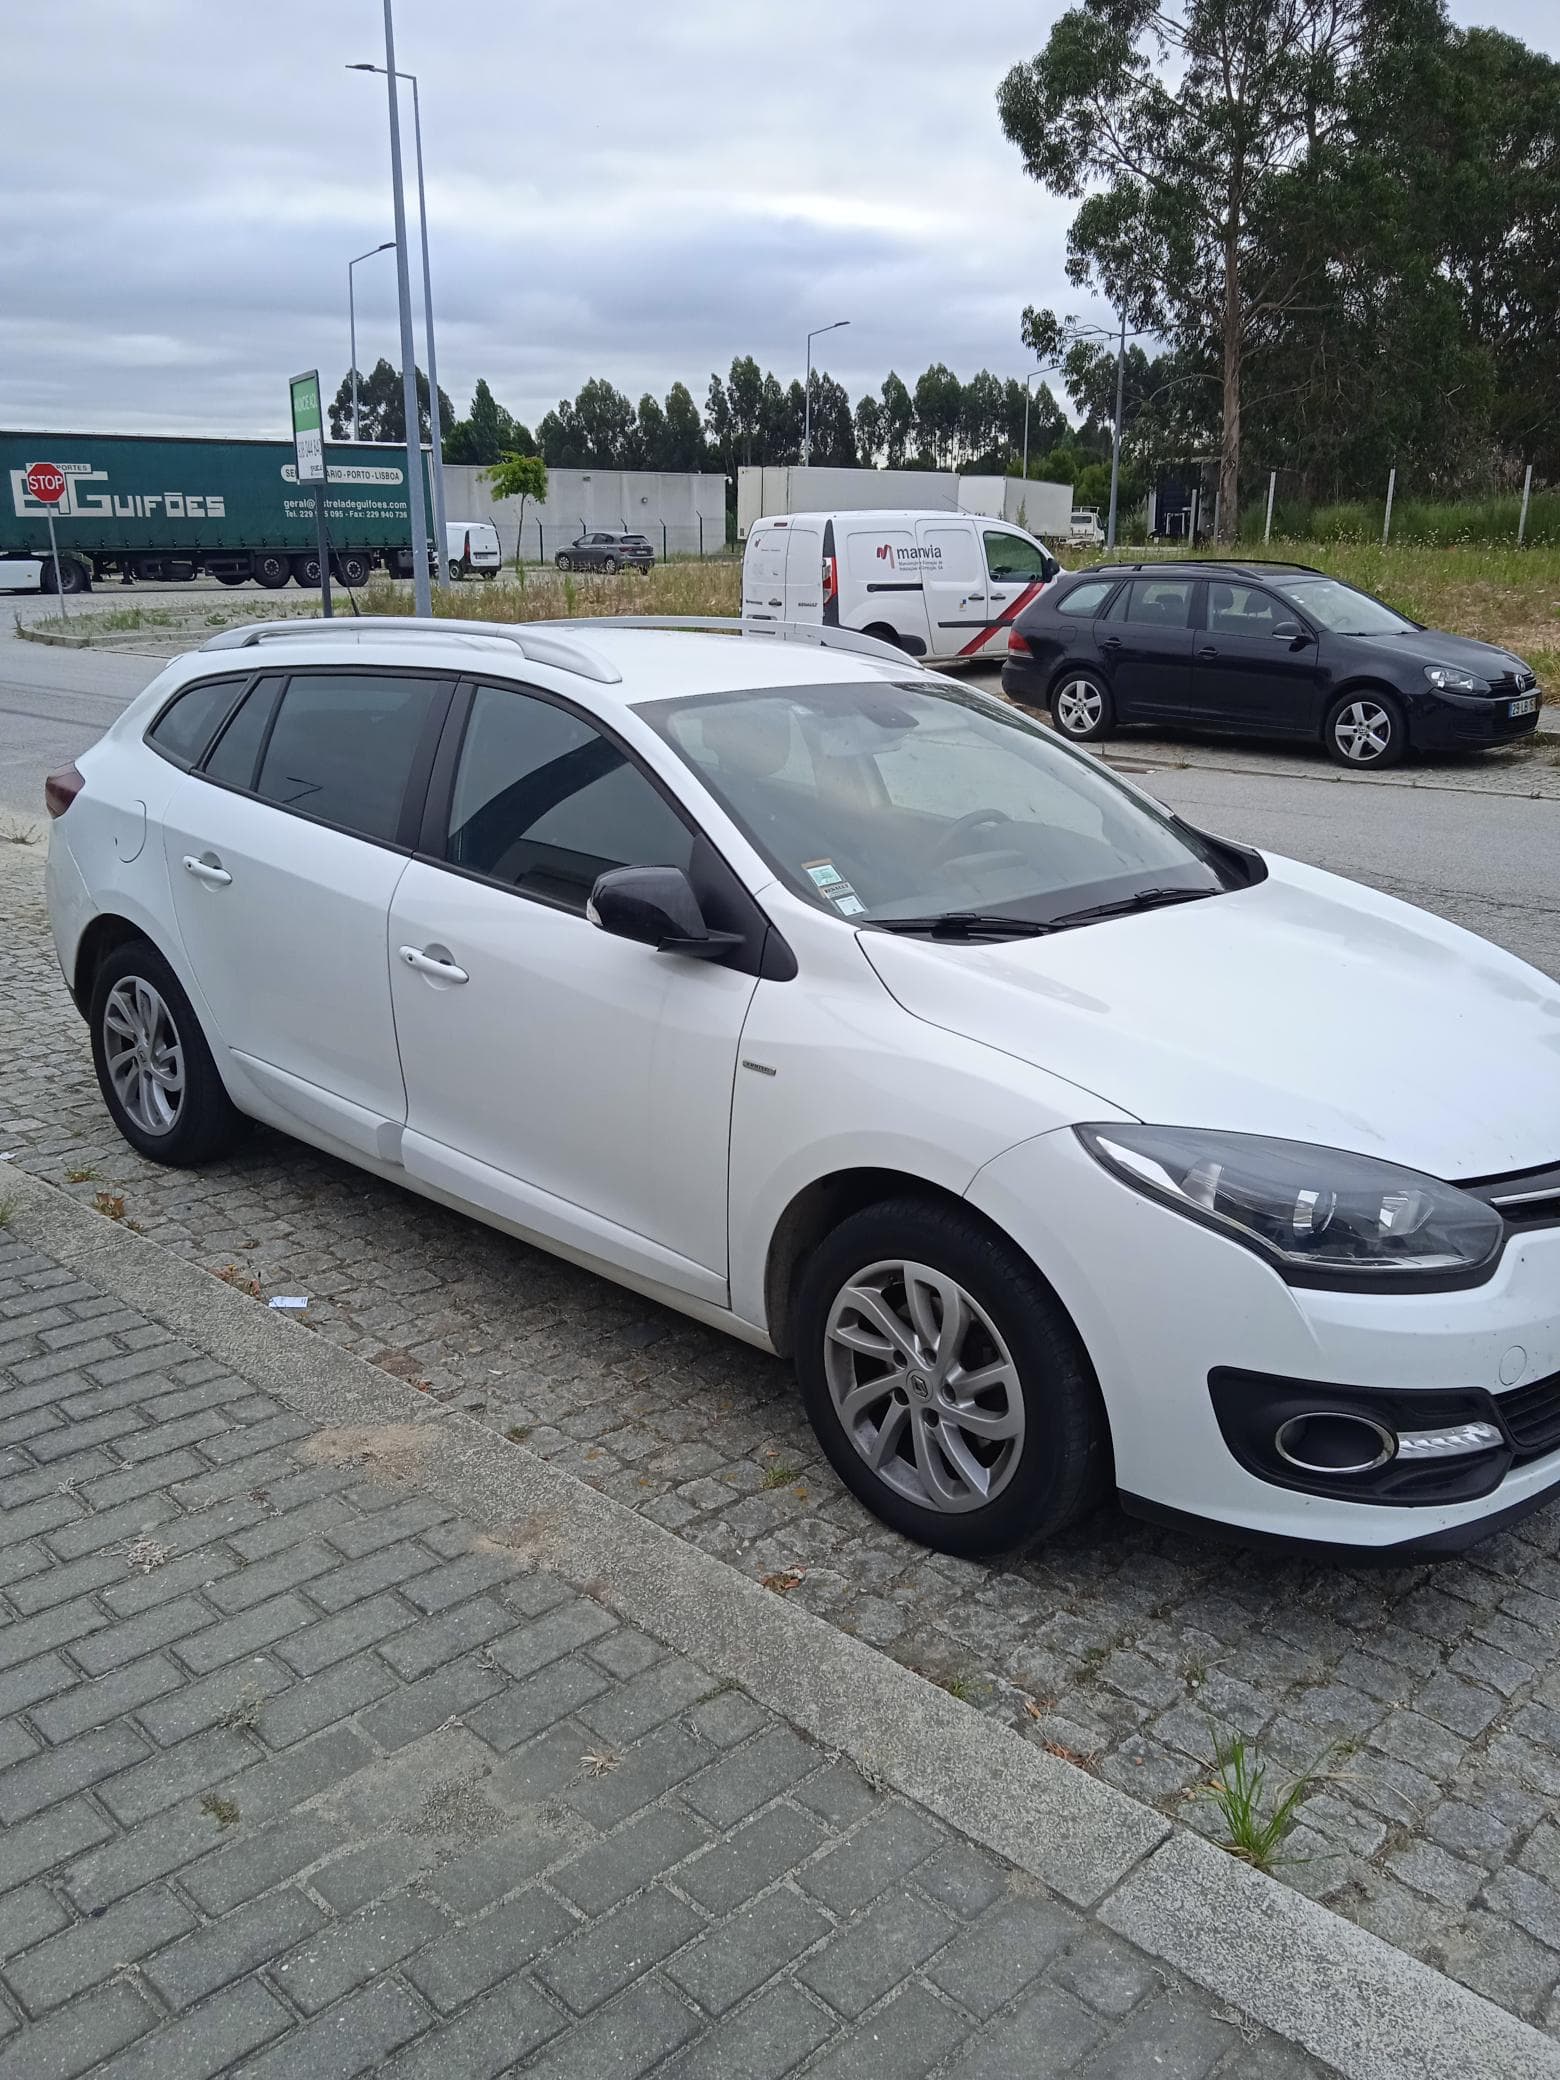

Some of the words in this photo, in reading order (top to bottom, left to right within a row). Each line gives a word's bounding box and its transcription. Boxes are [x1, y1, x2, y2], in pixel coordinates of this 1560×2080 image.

[347, 470, 371, 480] PORTO
[374, 471, 400, 481] LISBOA
[29, 475, 63, 490] STOP
[299, 510, 314, 518] 229
[897, 544, 942, 560] manvia
